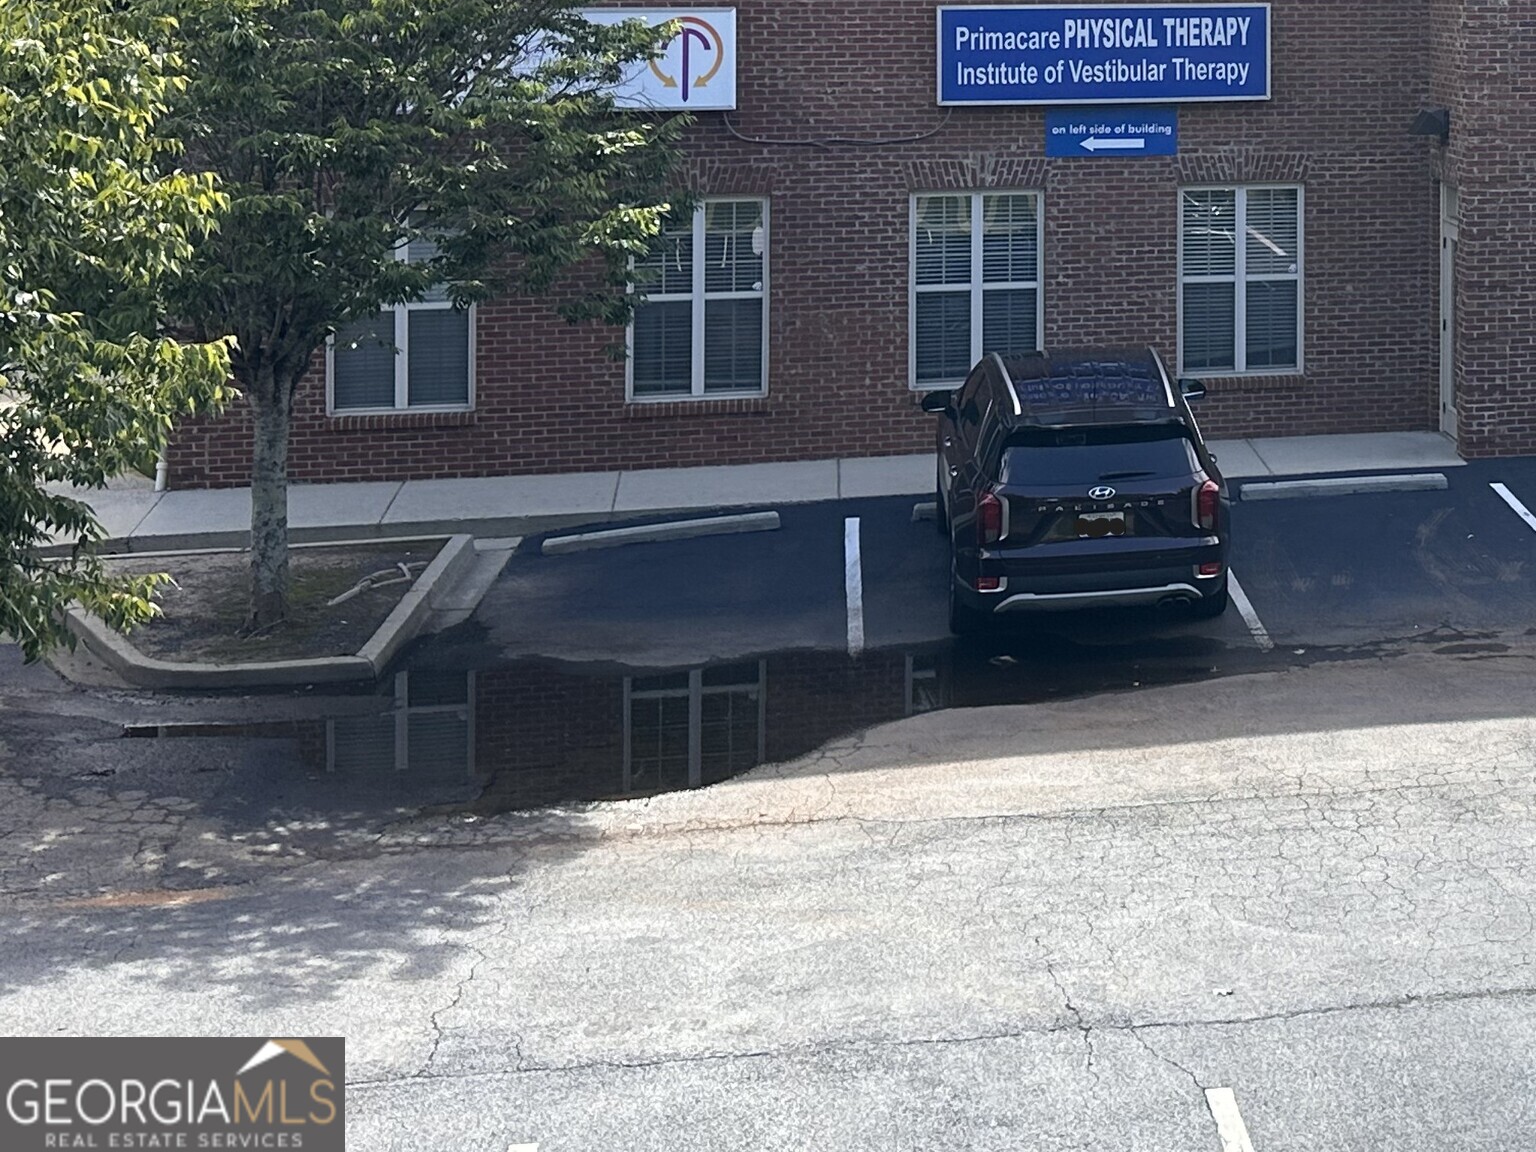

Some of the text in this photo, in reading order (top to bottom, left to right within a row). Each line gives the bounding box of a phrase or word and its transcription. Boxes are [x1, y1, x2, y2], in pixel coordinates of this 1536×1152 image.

[956, 17, 1251, 51] Primacare PHYSICAL THERAPY
[957, 58, 1249, 85] Institute of Vestibular Therapy
[1051, 123, 1172, 136] on left side of building
[1038, 499, 1164, 511] PALISADE
